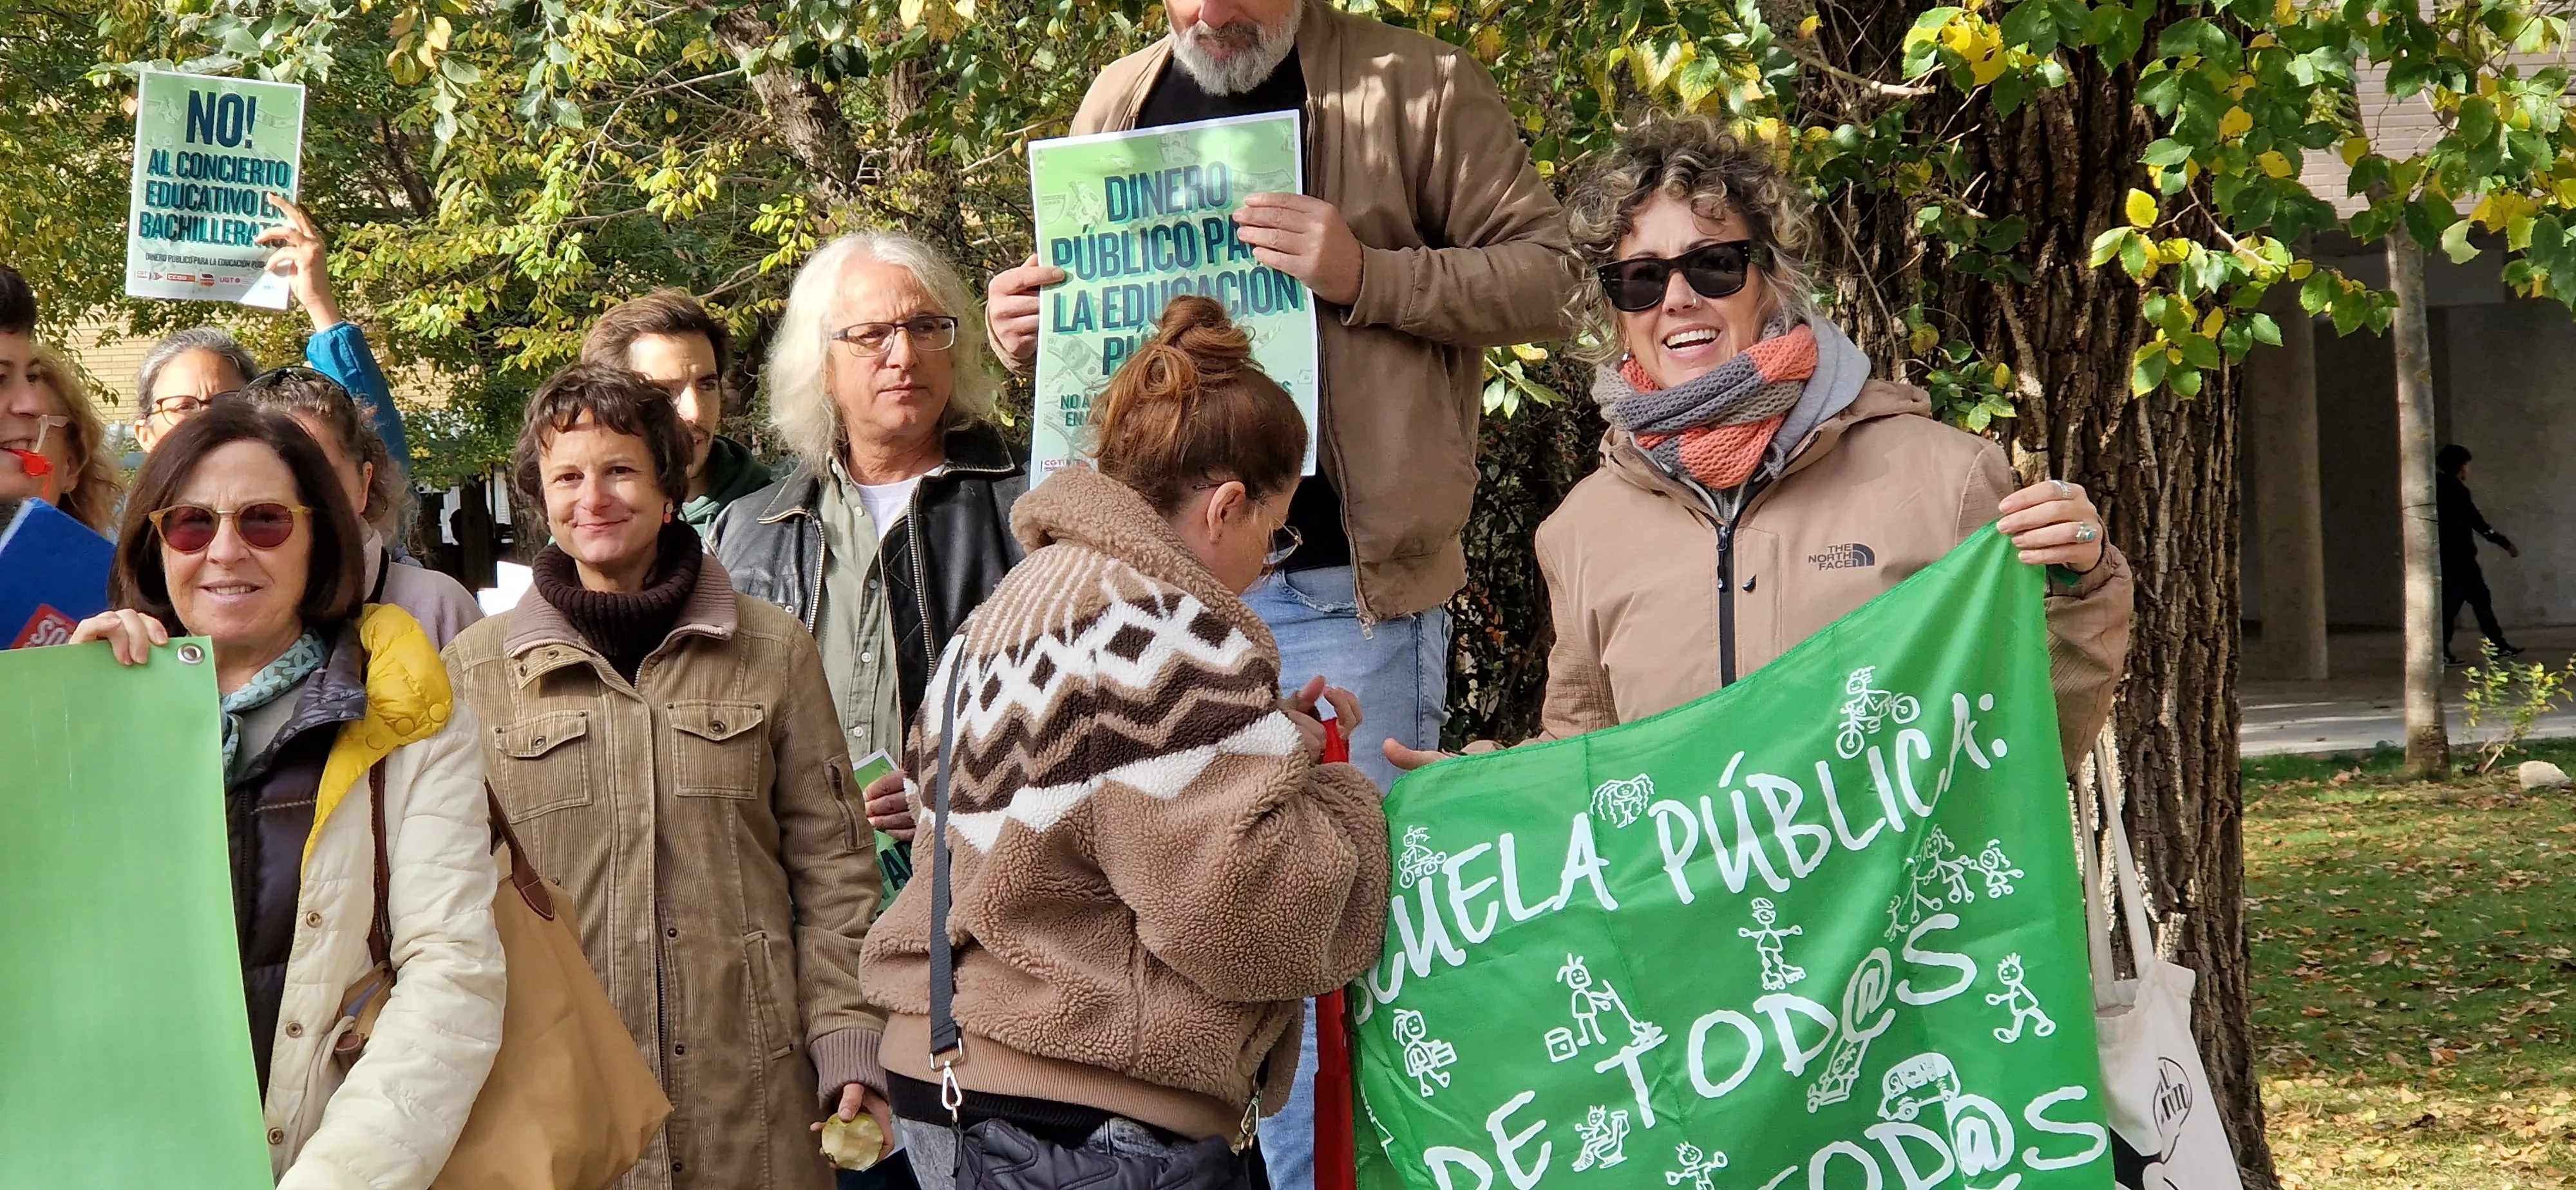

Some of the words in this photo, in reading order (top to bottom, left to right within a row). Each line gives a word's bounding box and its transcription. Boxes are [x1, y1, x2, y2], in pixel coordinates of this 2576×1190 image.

[185, 89, 256, 149] NO!
[147, 149, 172, 177] AL
[176, 151, 291, 189] CONCIERTO
[145, 180, 258, 217] EDUCATIVO
[1104, 161, 1231, 223] DINERO
[193, 256, 209, 266] PARA
[209, 257, 217, 266] LA
[1050, 220, 1200, 281] PÚBLICO
[1202, 214, 1257, 265] PA
[1052, 287, 1094, 333] LA
[1060, 393, 1080, 410] NO
[1808, 552, 1852, 563] NORTH
[1819, 560, 1853, 571] FACE
[1828, 543, 1852, 553] THE
[1648, 692, 2007, 905] PÚBLICA:
[1595, 913, 1978, 1129] TOD@S
[1759, 1086, 2108, 1190] OD@S
